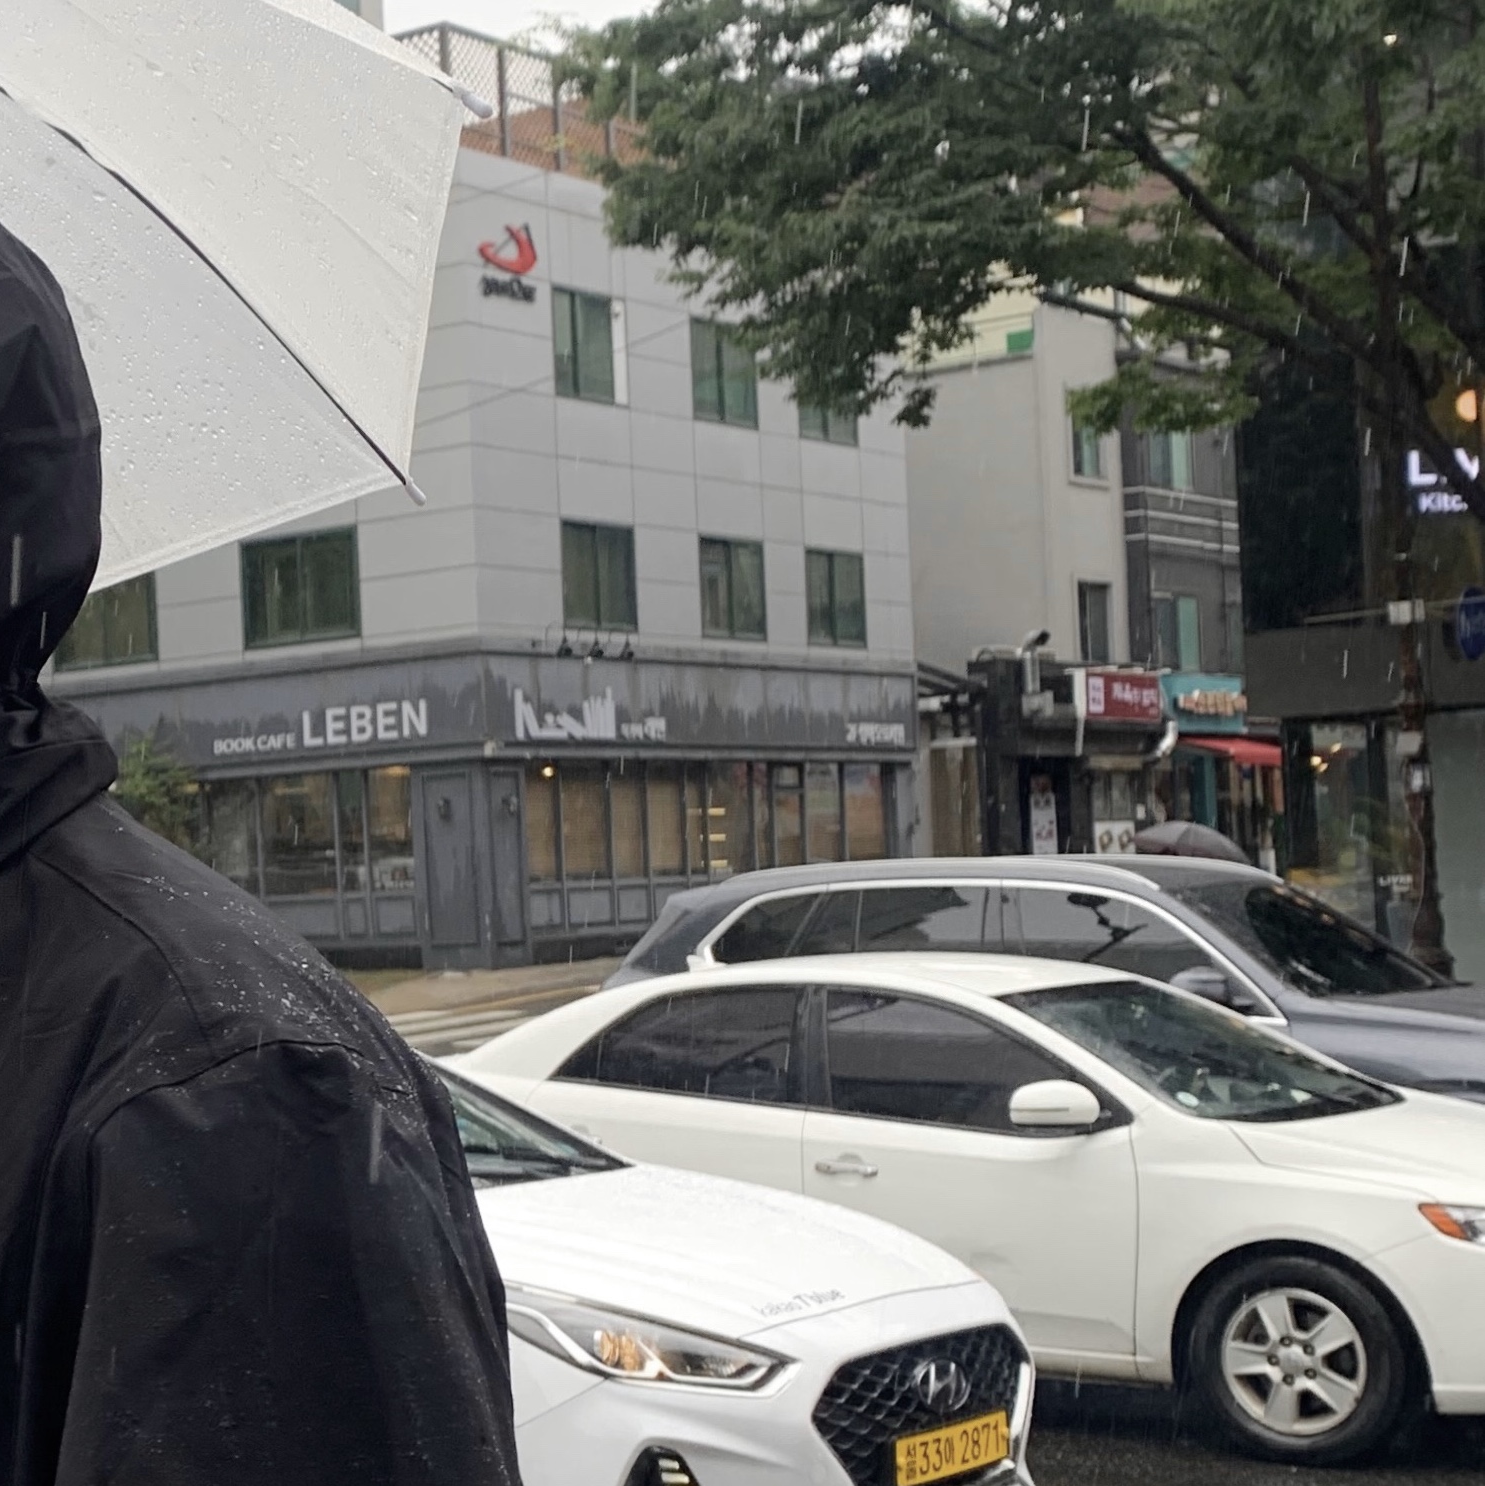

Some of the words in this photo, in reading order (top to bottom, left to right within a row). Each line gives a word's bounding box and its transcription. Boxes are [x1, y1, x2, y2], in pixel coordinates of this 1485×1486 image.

[1407, 448, 1480, 487] LV
[1418, 492, 1469, 514] Kitc
[213, 736, 256, 755] BOOK
[257, 732, 296, 751] CAFE
[302, 698, 428, 748] LEBEN
[919, 1434, 955, 1475] 33아
[960, 1420, 1000, 1465] 2871
